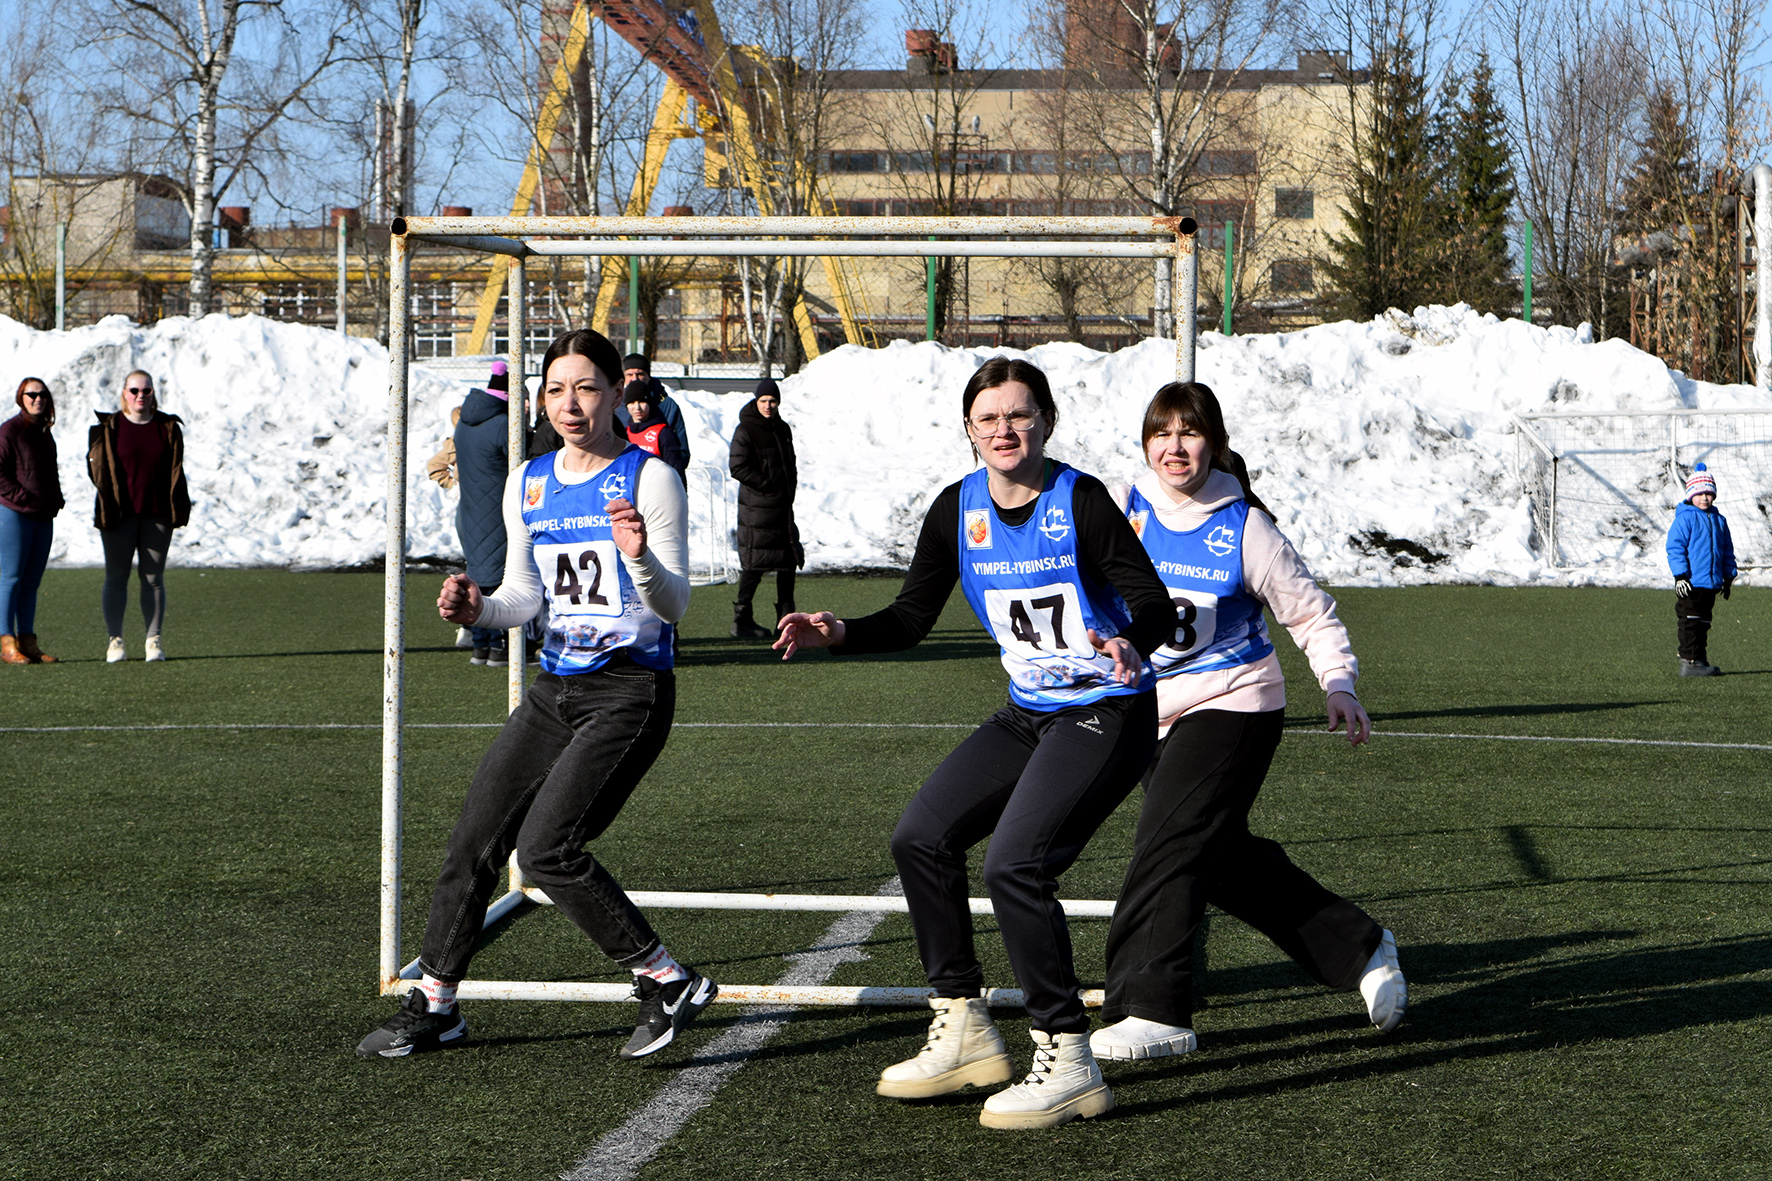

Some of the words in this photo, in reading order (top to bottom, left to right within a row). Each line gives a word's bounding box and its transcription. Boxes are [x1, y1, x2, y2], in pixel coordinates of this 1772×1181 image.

[972, 554, 1076, 575] VYMPEL-RYBINSK.RU
[1151, 559, 1230, 582] -RYBINSK.RU
[554, 550, 609, 606] 42
[1009, 594, 1069, 651] 47
[1076, 721, 1104, 735] DEMIX
